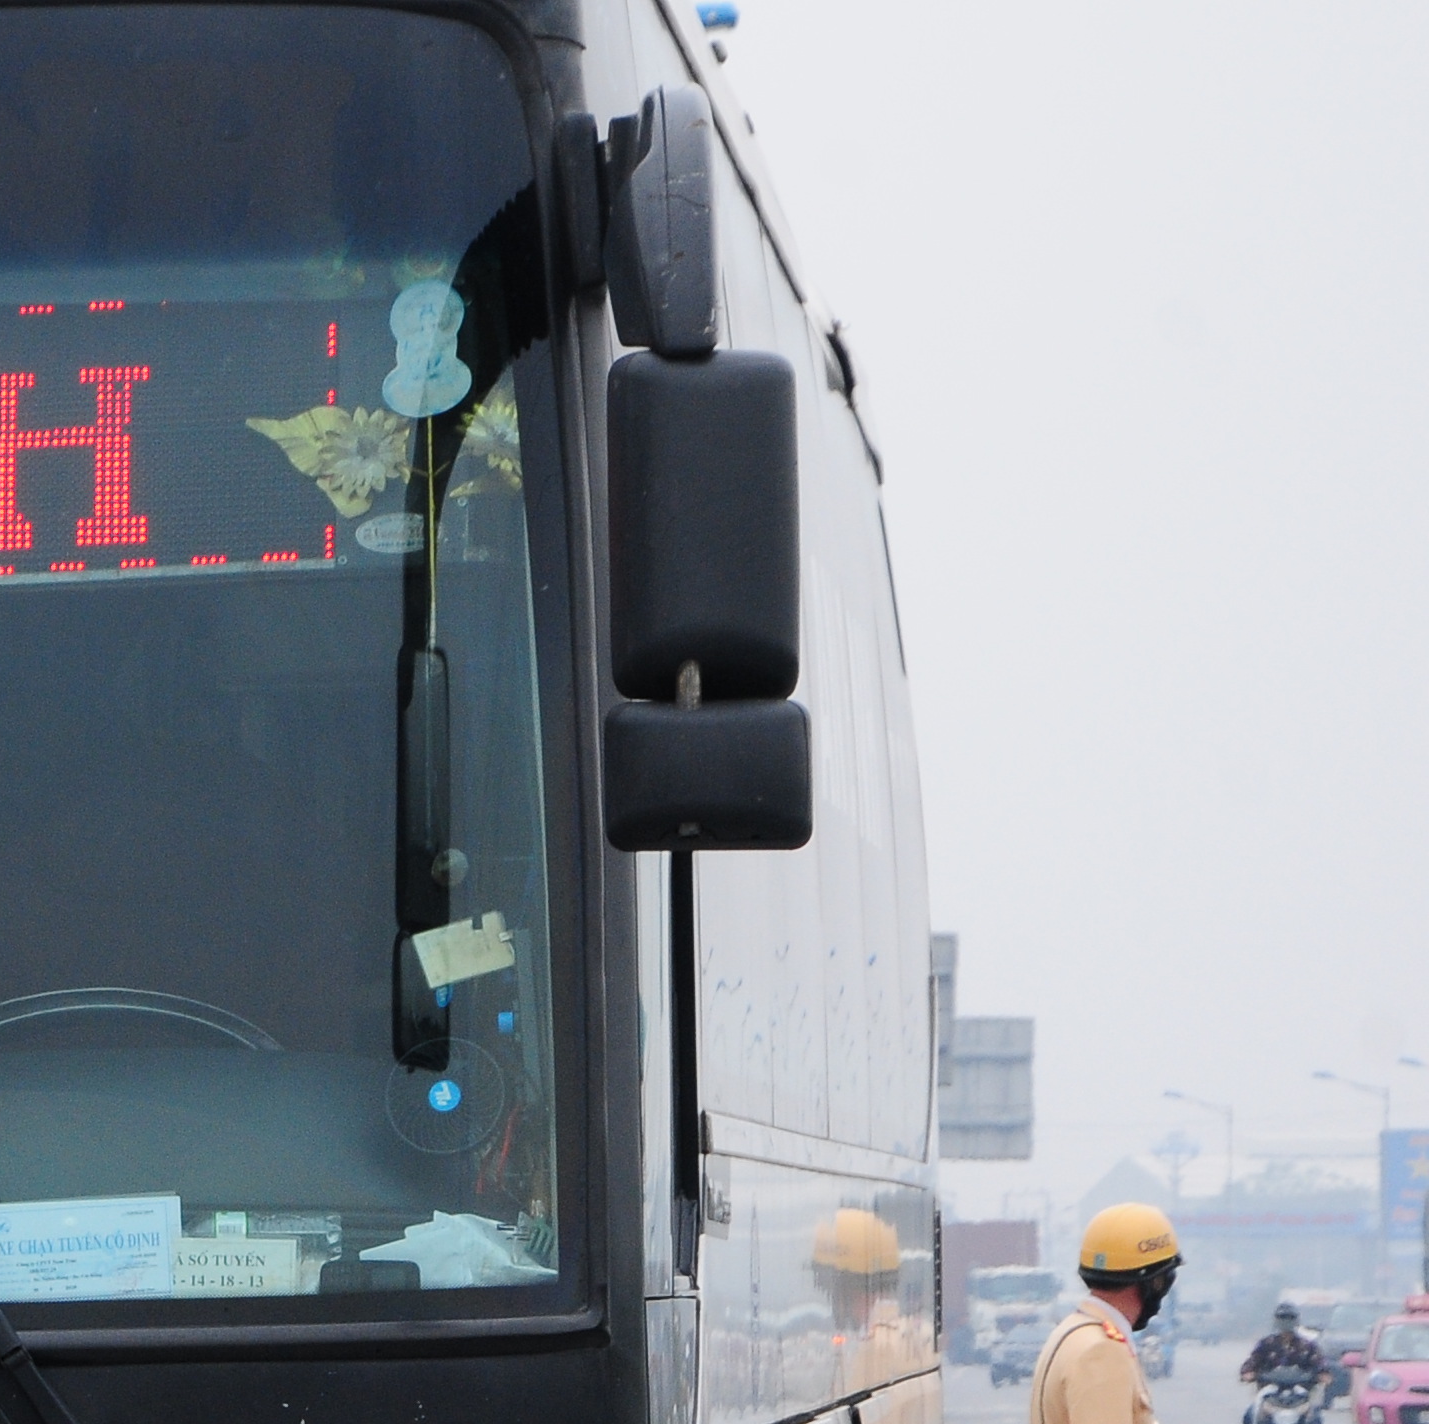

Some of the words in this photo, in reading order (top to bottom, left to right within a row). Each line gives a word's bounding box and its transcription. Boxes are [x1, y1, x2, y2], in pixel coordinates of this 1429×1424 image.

[18, 1237, 54, 1257] CHẠY
[127, 1231, 160, 1252] ĐỊNH
[188, 1250, 208, 1267] SỐ
[212, 1250, 266, 1267] TUYẾN
[191, 1274, 205, 1287] 14
[221, 1274, 235, 1287] 18
[250, 1274, 264, 1288] 13
